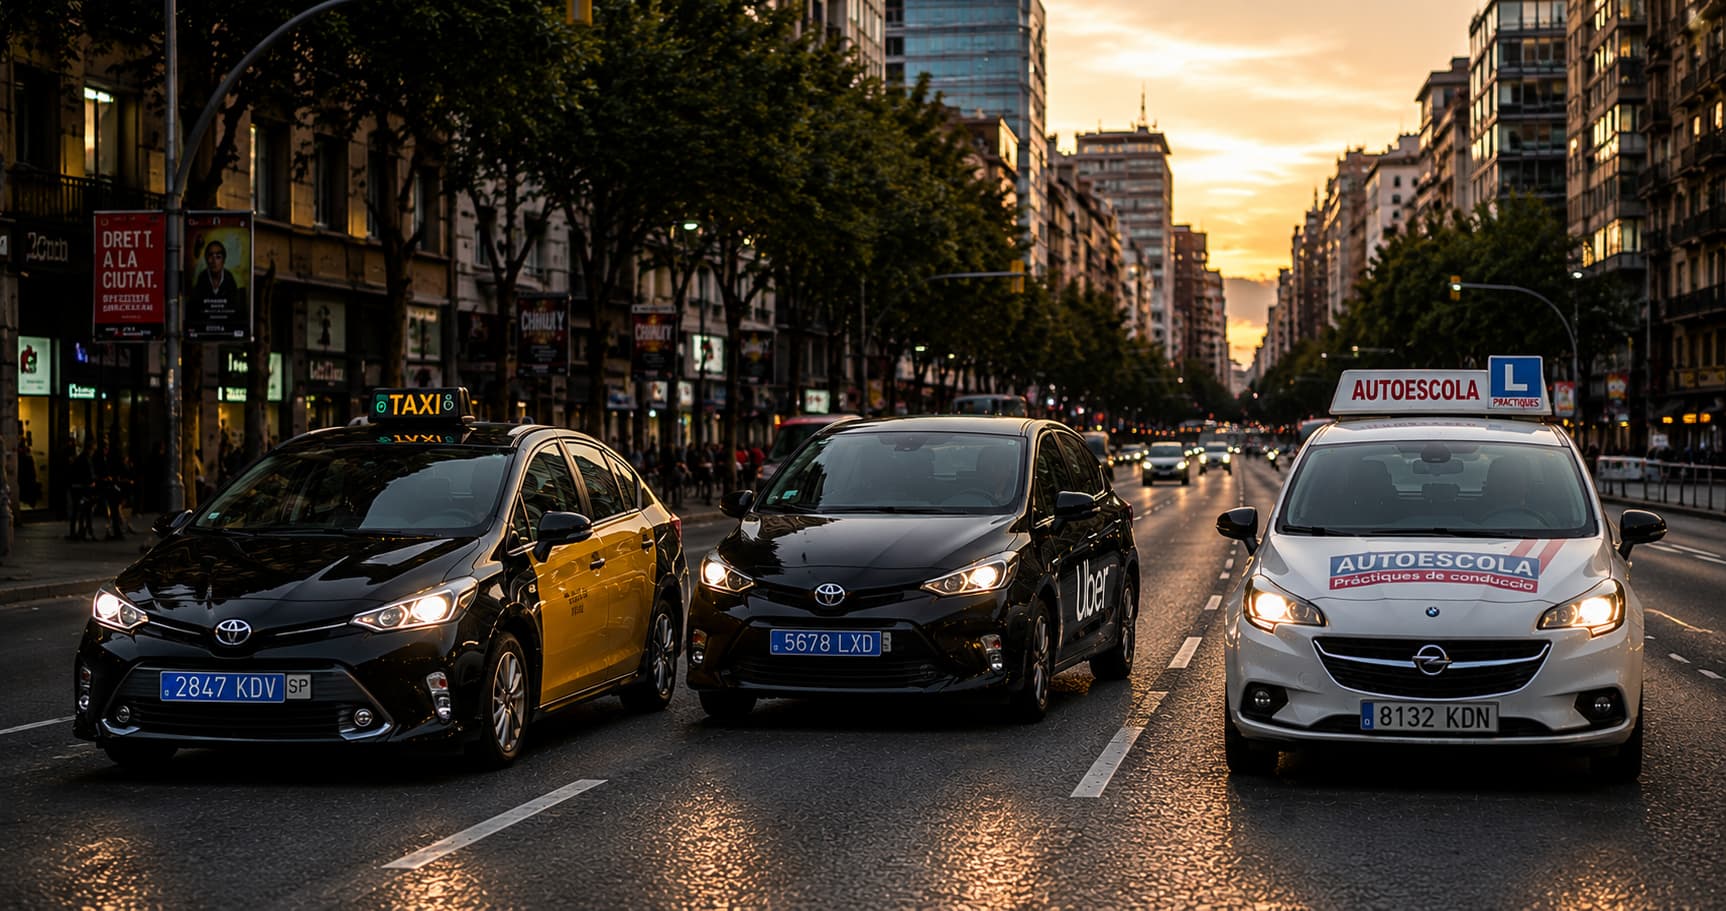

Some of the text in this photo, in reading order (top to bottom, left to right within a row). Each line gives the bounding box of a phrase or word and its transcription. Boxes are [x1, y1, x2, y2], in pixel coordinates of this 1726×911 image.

[103, 250, 138, 269] A LA
[102, 270, 158, 289] CIUTAT.
[1504, 364, 1528, 391] L
[1352, 379, 1480, 400] AUTOESCOLA
[389, 394, 441, 415] TAXI
[1337, 553, 1532, 576] AUTOESCOLA
[1425, 571, 1445, 580] de
[1076, 558, 1109, 622] Uber
[784, 633, 831, 653] 5678
[838, 634, 873, 653] LXD
[176, 676, 276, 699] 2847 KDV
[288, 678, 309, 694] SP
[1379, 705, 1435, 729] 8132
[1446, 706, 1490, 730] KDN
